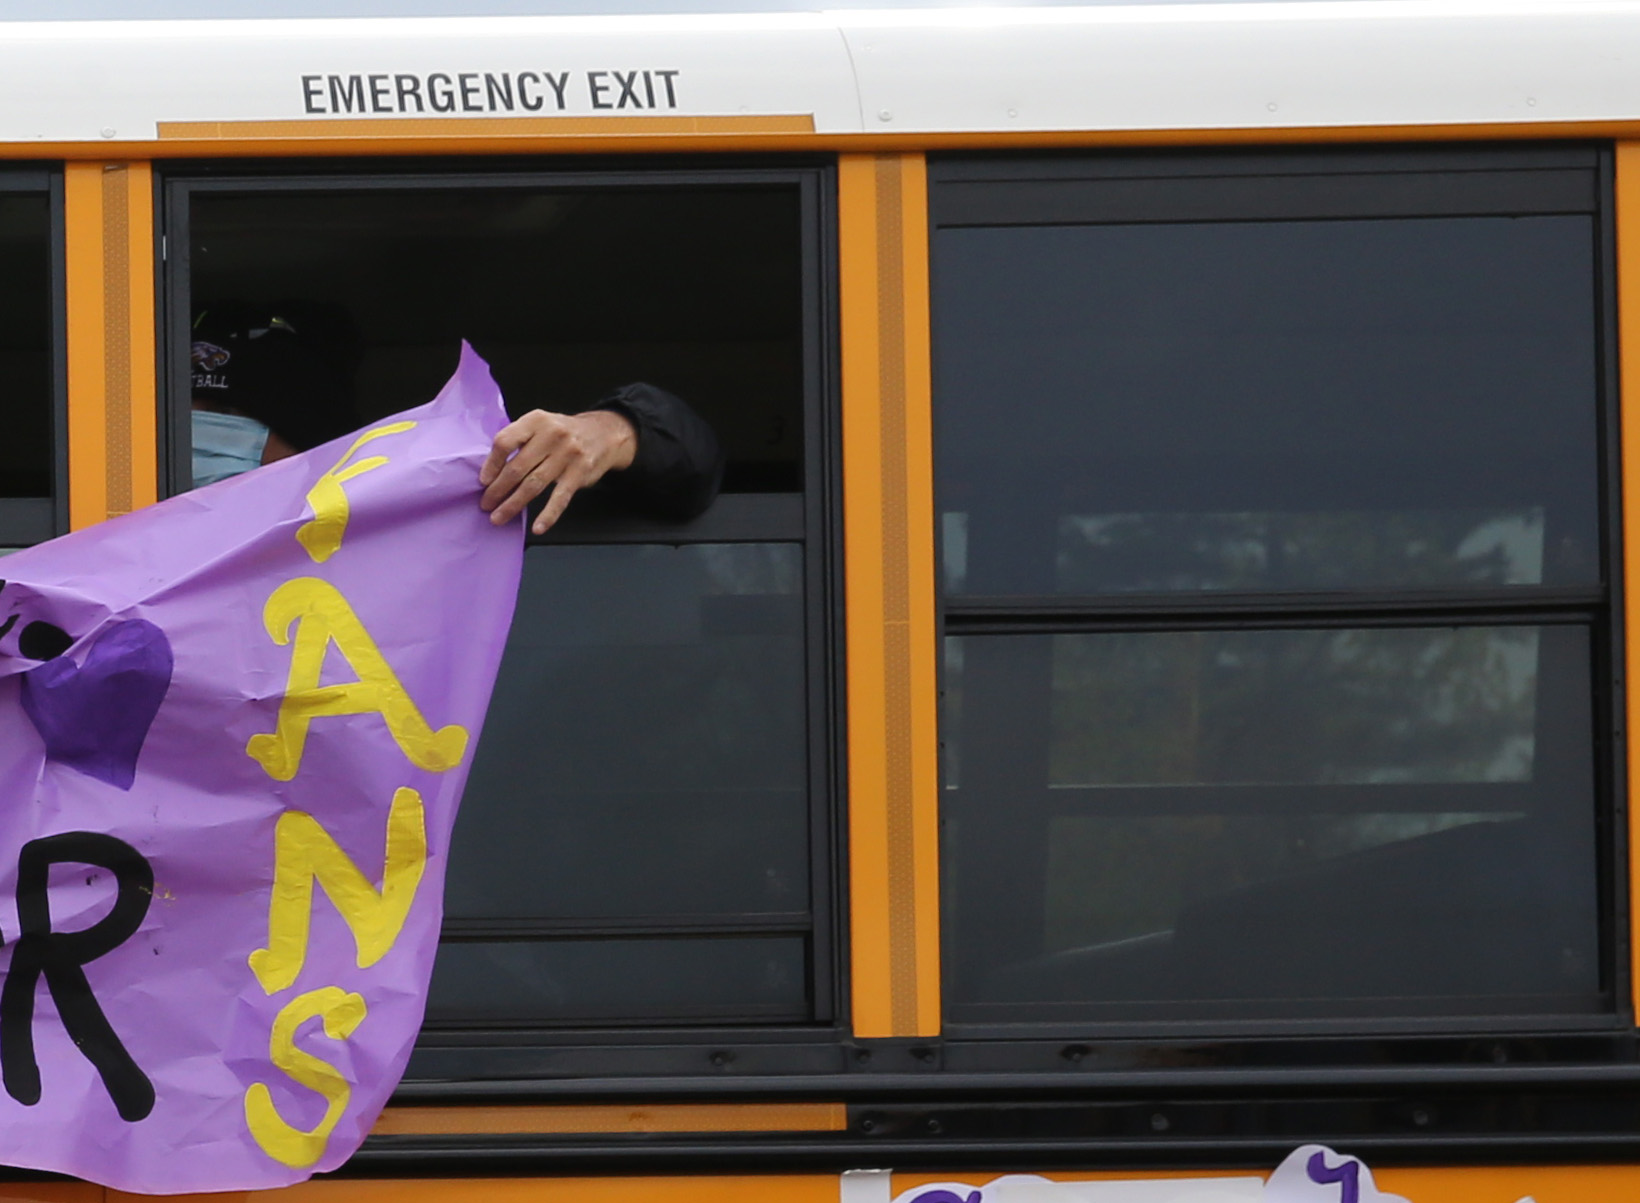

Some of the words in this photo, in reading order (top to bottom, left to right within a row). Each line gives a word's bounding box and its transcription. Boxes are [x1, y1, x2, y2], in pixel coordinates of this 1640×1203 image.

[301, 71, 571, 114] EMERGENCY
[587, 69, 681, 110] EXIT
[244, 421, 468, 1169] FANS
